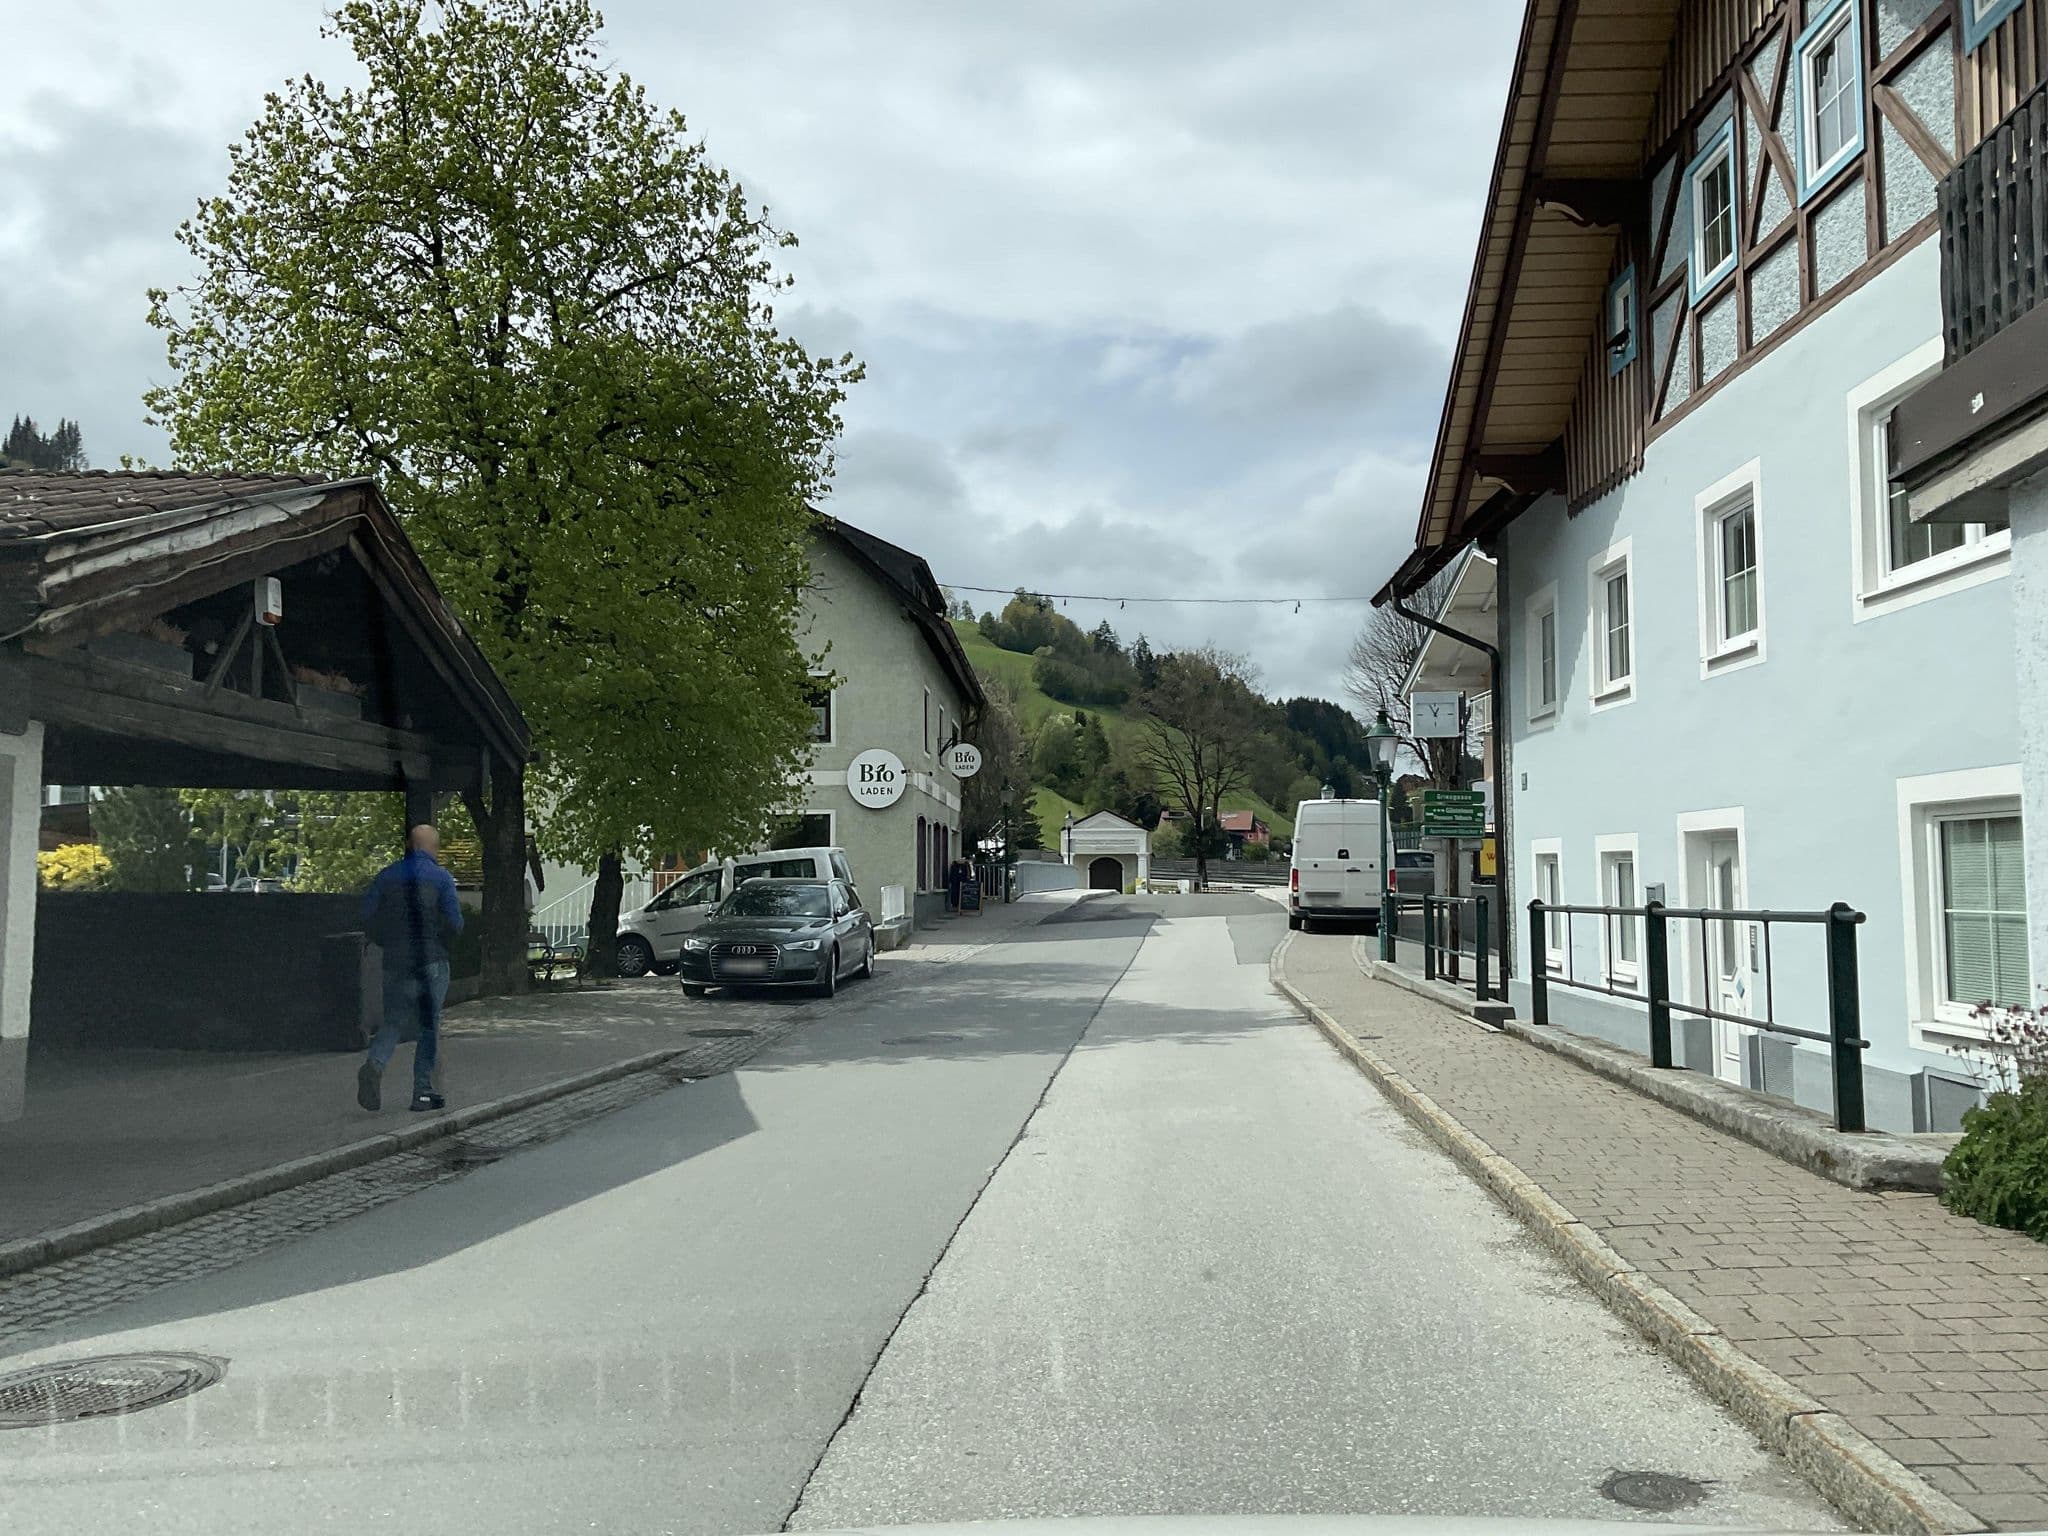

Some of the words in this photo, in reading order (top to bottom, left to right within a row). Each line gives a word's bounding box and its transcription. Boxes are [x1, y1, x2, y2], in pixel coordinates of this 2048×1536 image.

[955, 751, 975, 763] Bio
[860, 763, 895, 782] Bio
[860, 787, 893, 795] LADEN
